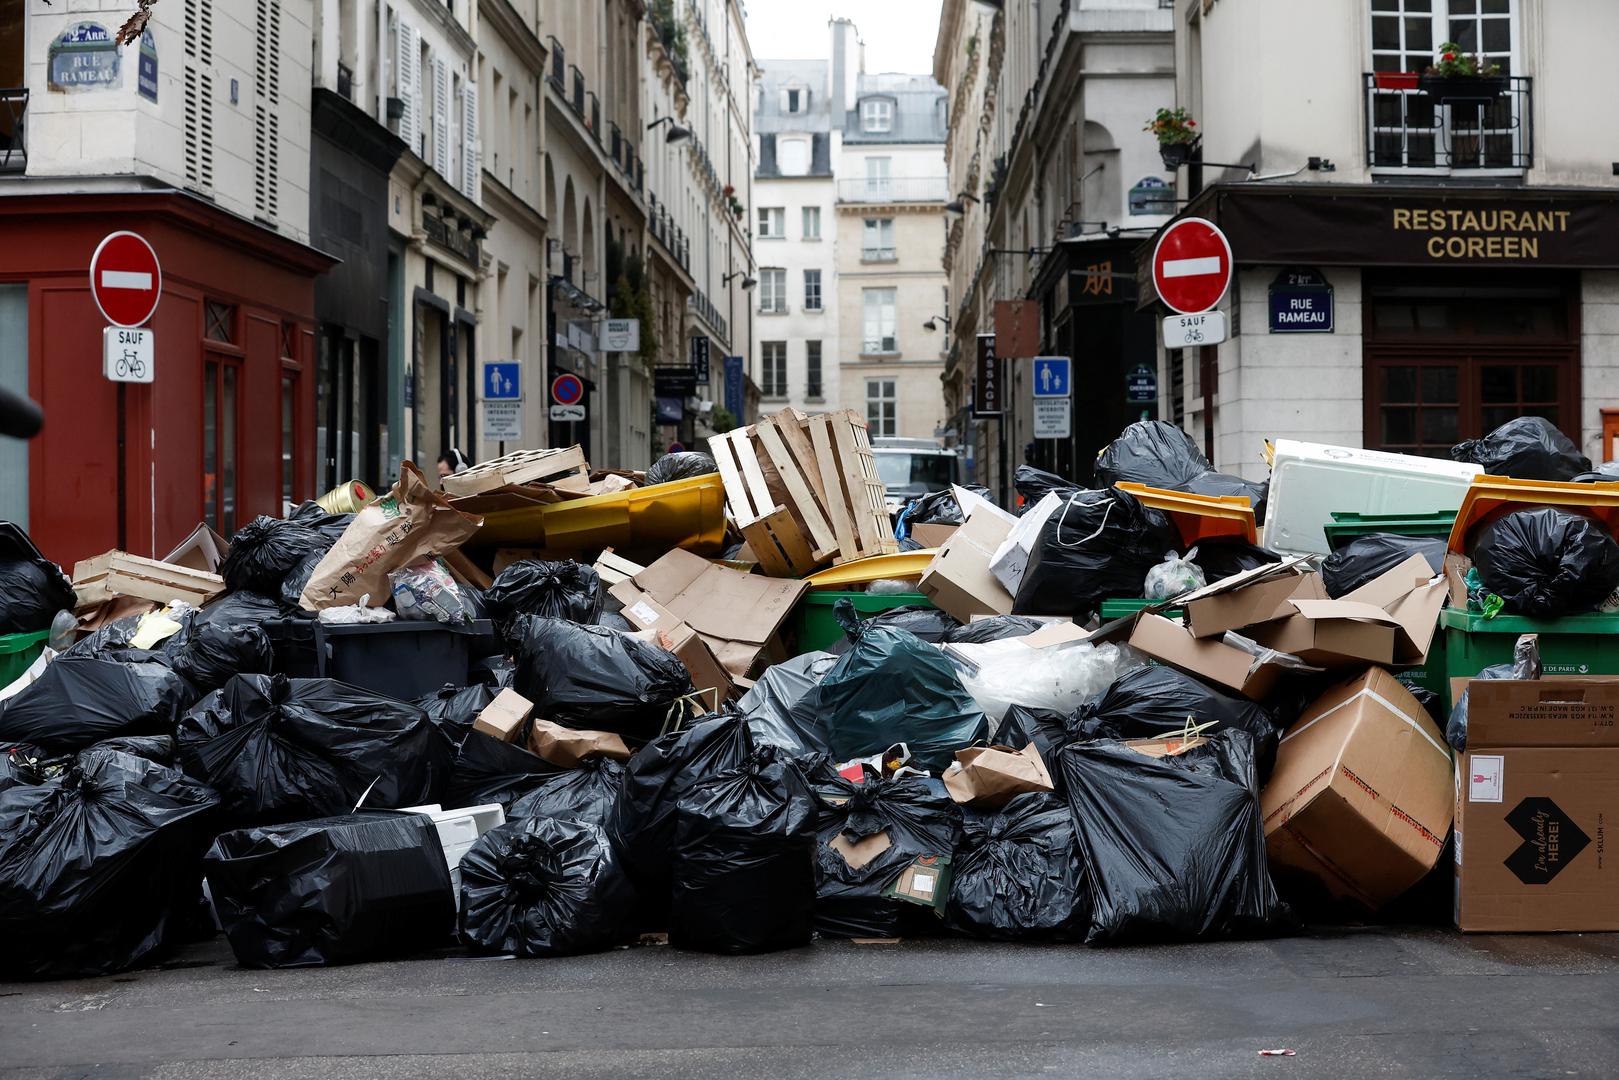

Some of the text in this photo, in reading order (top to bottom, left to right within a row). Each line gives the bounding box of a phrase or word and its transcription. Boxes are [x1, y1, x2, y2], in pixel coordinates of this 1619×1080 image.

[74, 56, 100, 67] RUE
[1393, 209, 1571, 231] RESTAURANT
[1427, 236, 1539, 258] COREEN
[1290, 298, 1313, 310] RUE
[1180, 316, 1206, 327] SAUF
[1278, 311, 1325, 323] RAMEAU
[119, 331, 144, 345] SAUF
[985, 338, 995, 411] MASSAGE
[1530, 808, 1550, 853] already
[1548, 821, 1560, 862] HERE!
